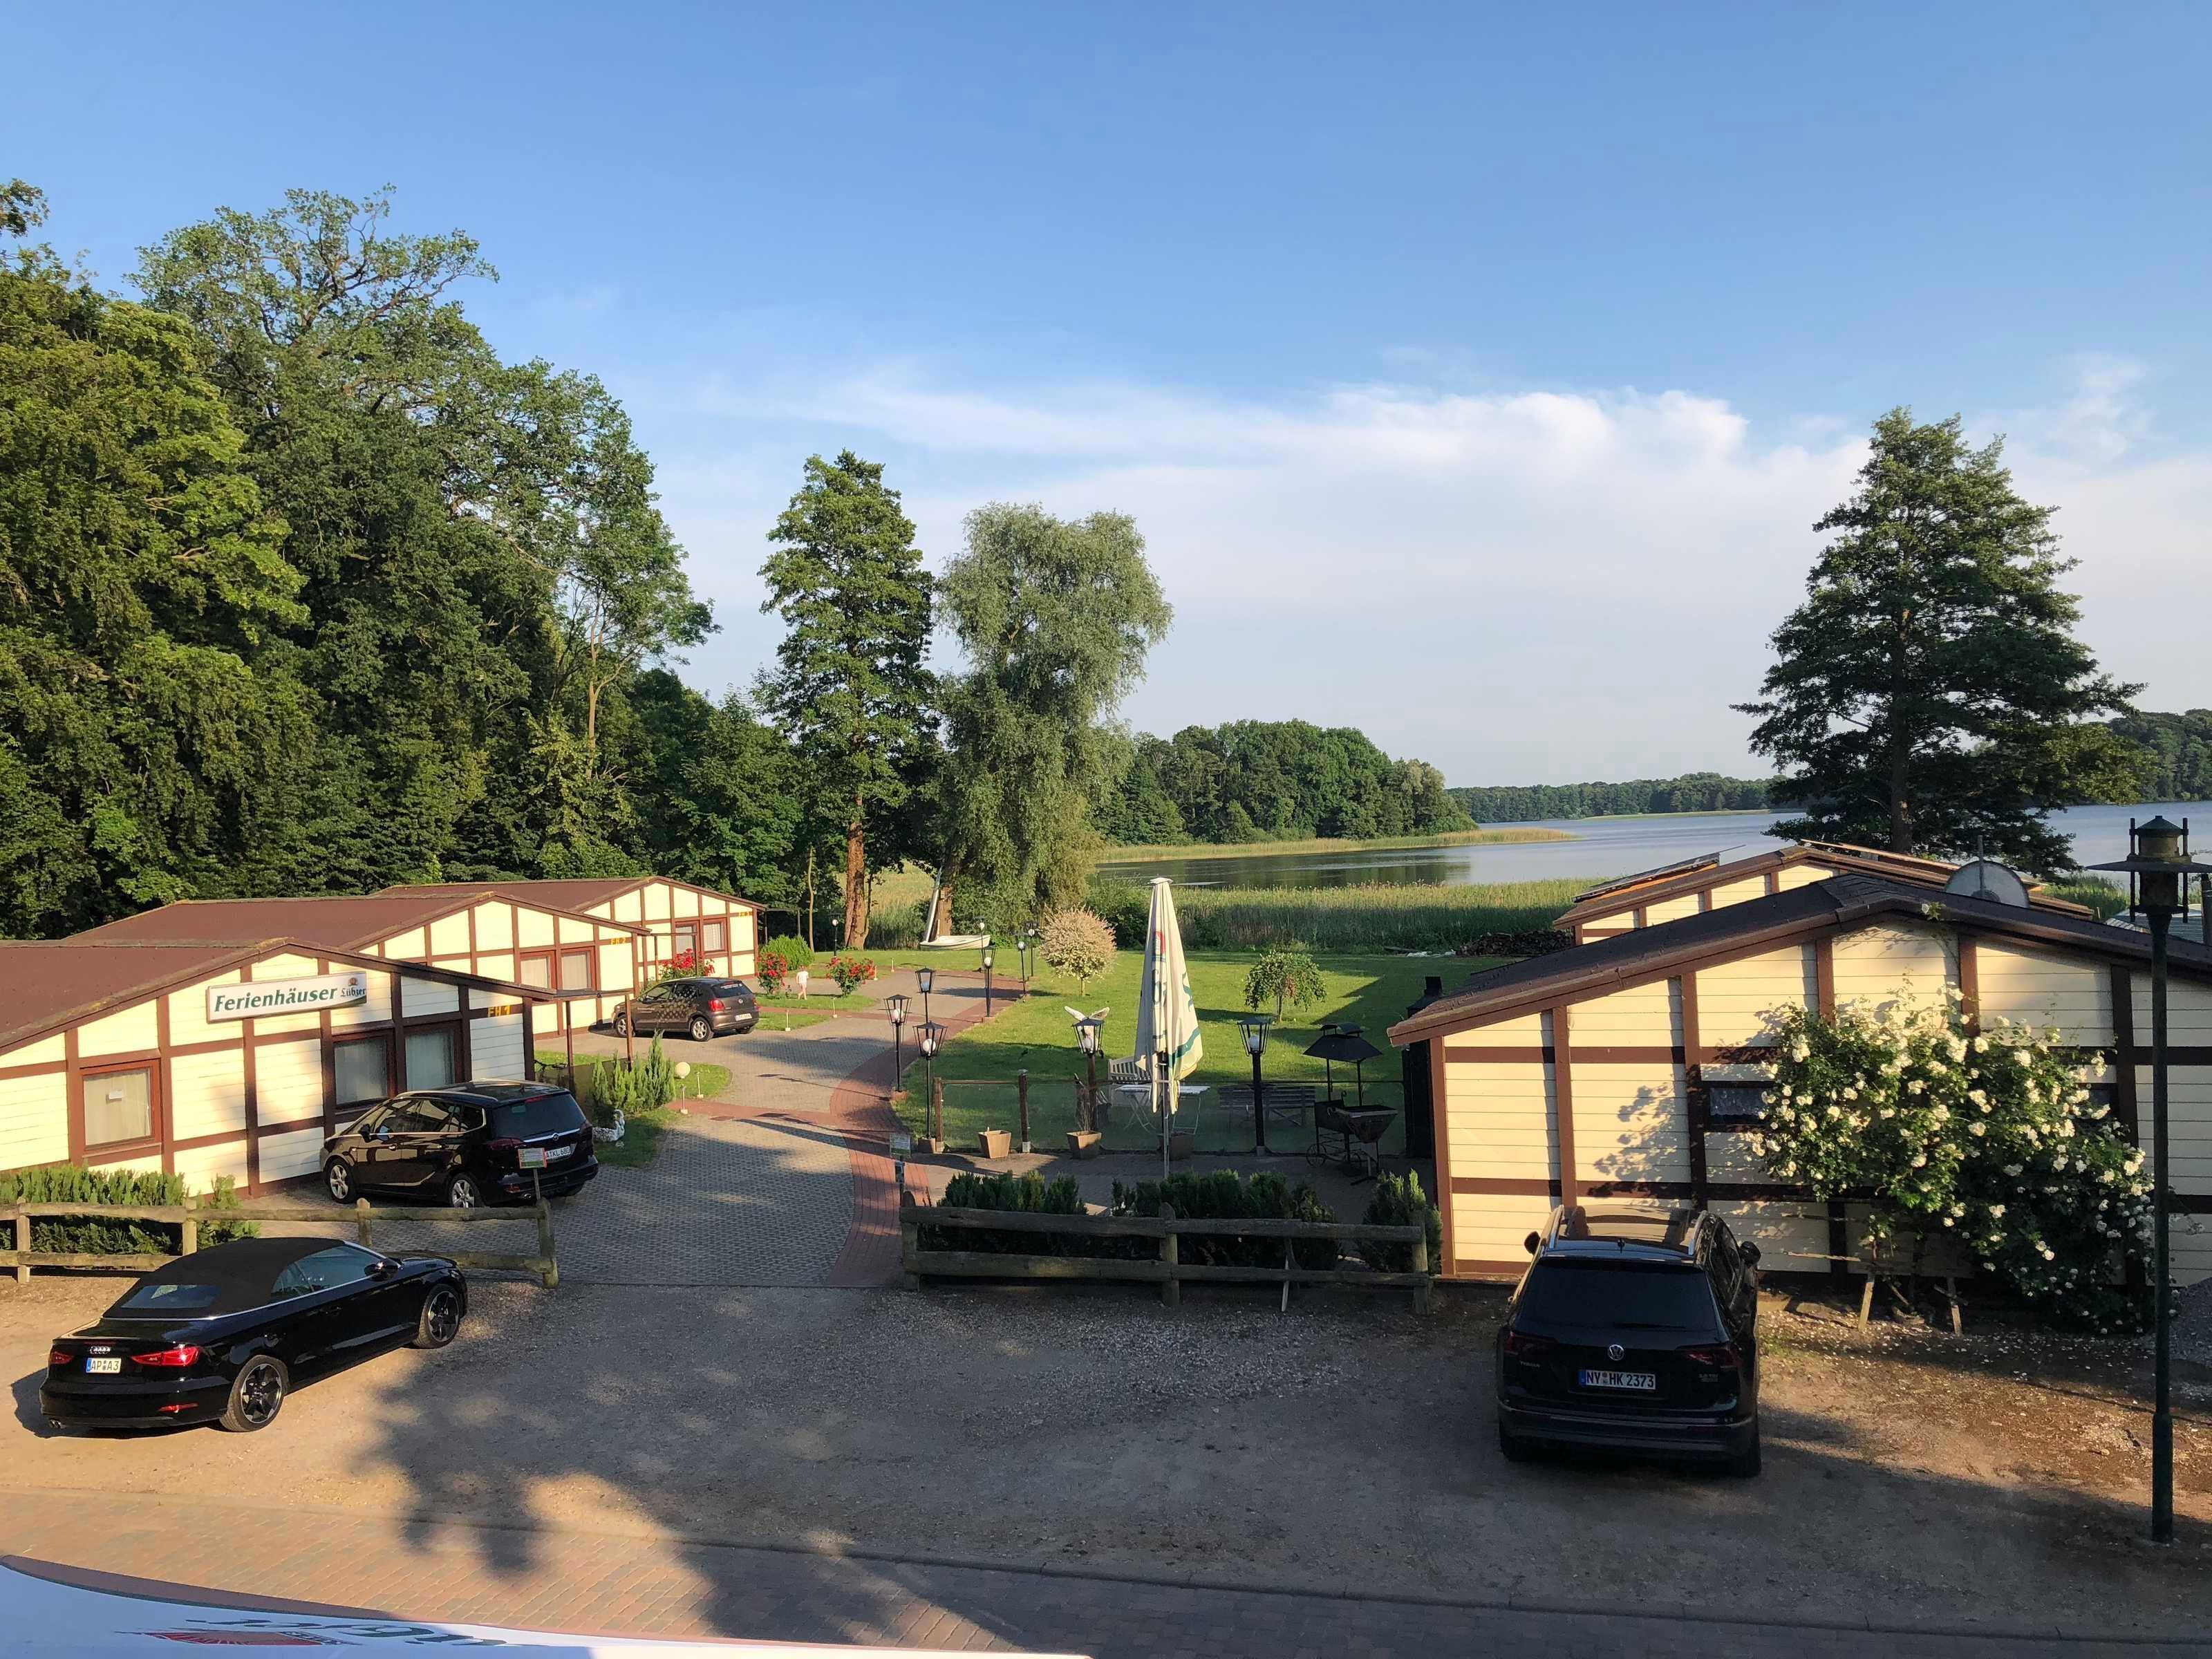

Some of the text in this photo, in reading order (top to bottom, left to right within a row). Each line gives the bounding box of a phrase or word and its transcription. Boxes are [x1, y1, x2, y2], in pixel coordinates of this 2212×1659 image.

[341, 986, 366, 997] Lübzer
[214, 987, 337, 1012] Ferienhäuser
[488, 1005, 510, 1018] FH 1
[91, 1360, 102, 1370] AP
[1586, 1371, 1654, 1387] NY HK 2373
